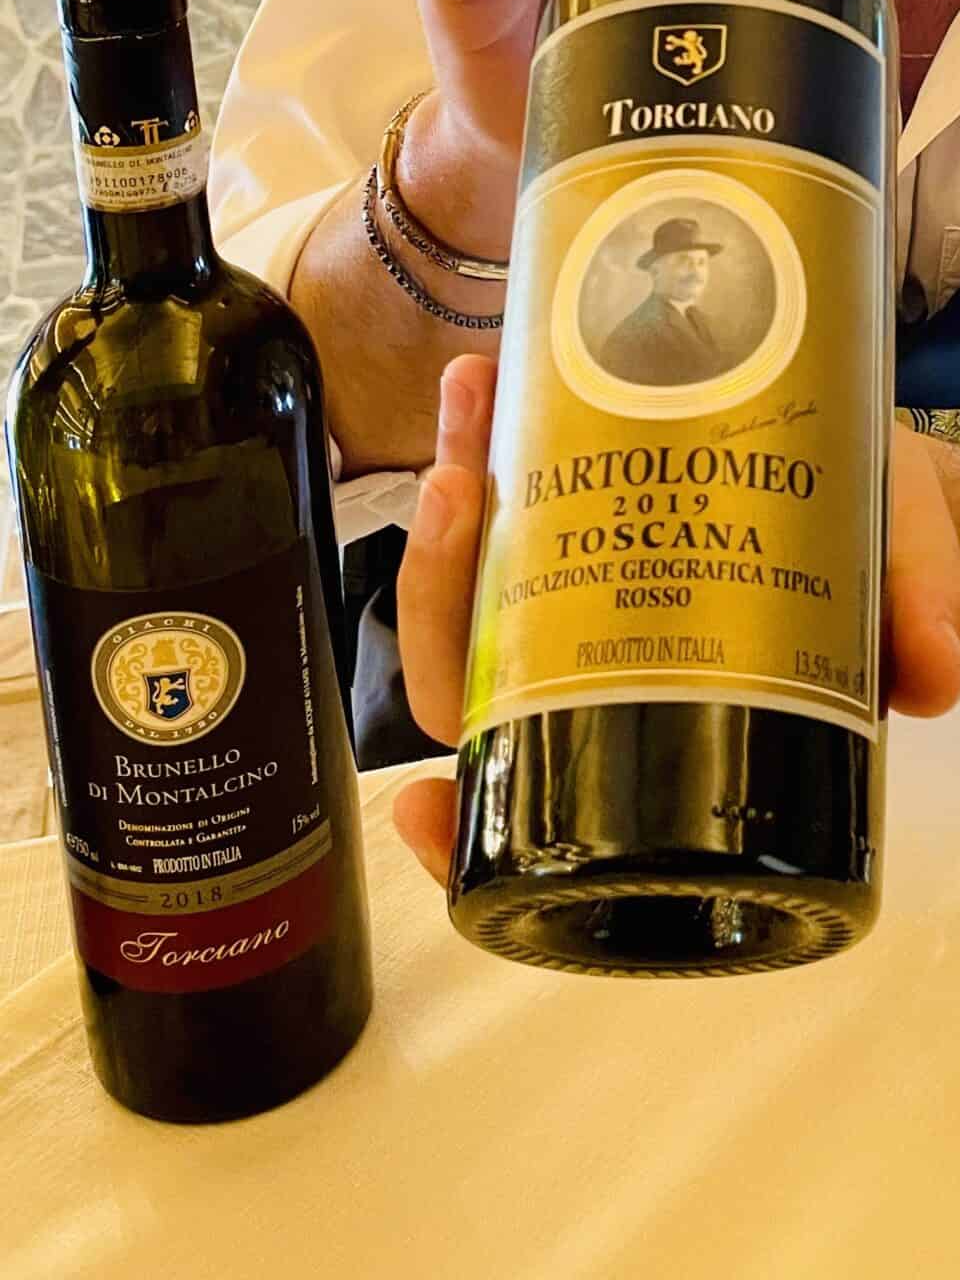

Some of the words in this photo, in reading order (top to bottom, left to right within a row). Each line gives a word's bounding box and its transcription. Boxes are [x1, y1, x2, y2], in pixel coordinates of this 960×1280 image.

[602, 98, 775, 137] TORCIANO
[523, 446, 817, 509] BARTOLOMEO
[612, 493, 710, 517] 2019
[556, 521, 763, 560] TOSCANA
[497, 562, 615, 610] INDICAZIONE
[620, 557, 765, 586] GEOGRAFICA
[771, 566, 832, 600] TIPICA
[615, 586, 692, 609] ROSSO
[575, 637, 655, 669] PRODOTTO
[656, 637, 674, 665] IN
[676, 636, 725, 666] ITALIA
[124, 720, 161, 738] DAL
[114, 748, 241, 779] BRUNELLO
[88, 781, 108, 801] DI
[116, 761, 278, 806] MONTALCINO
[118, 819, 194, 833] DENOMINAZIONE
[198, 819, 209, 828] DI
[125, 835, 185, 848] CONTROLLATA
[152, 856, 200, 875] PRODOTTO
[201, 852, 213, 870] IN
[213, 845, 243, 867] ITALIA
[160, 885, 224, 910] 2018
[120, 920, 290, 967] Torciano
